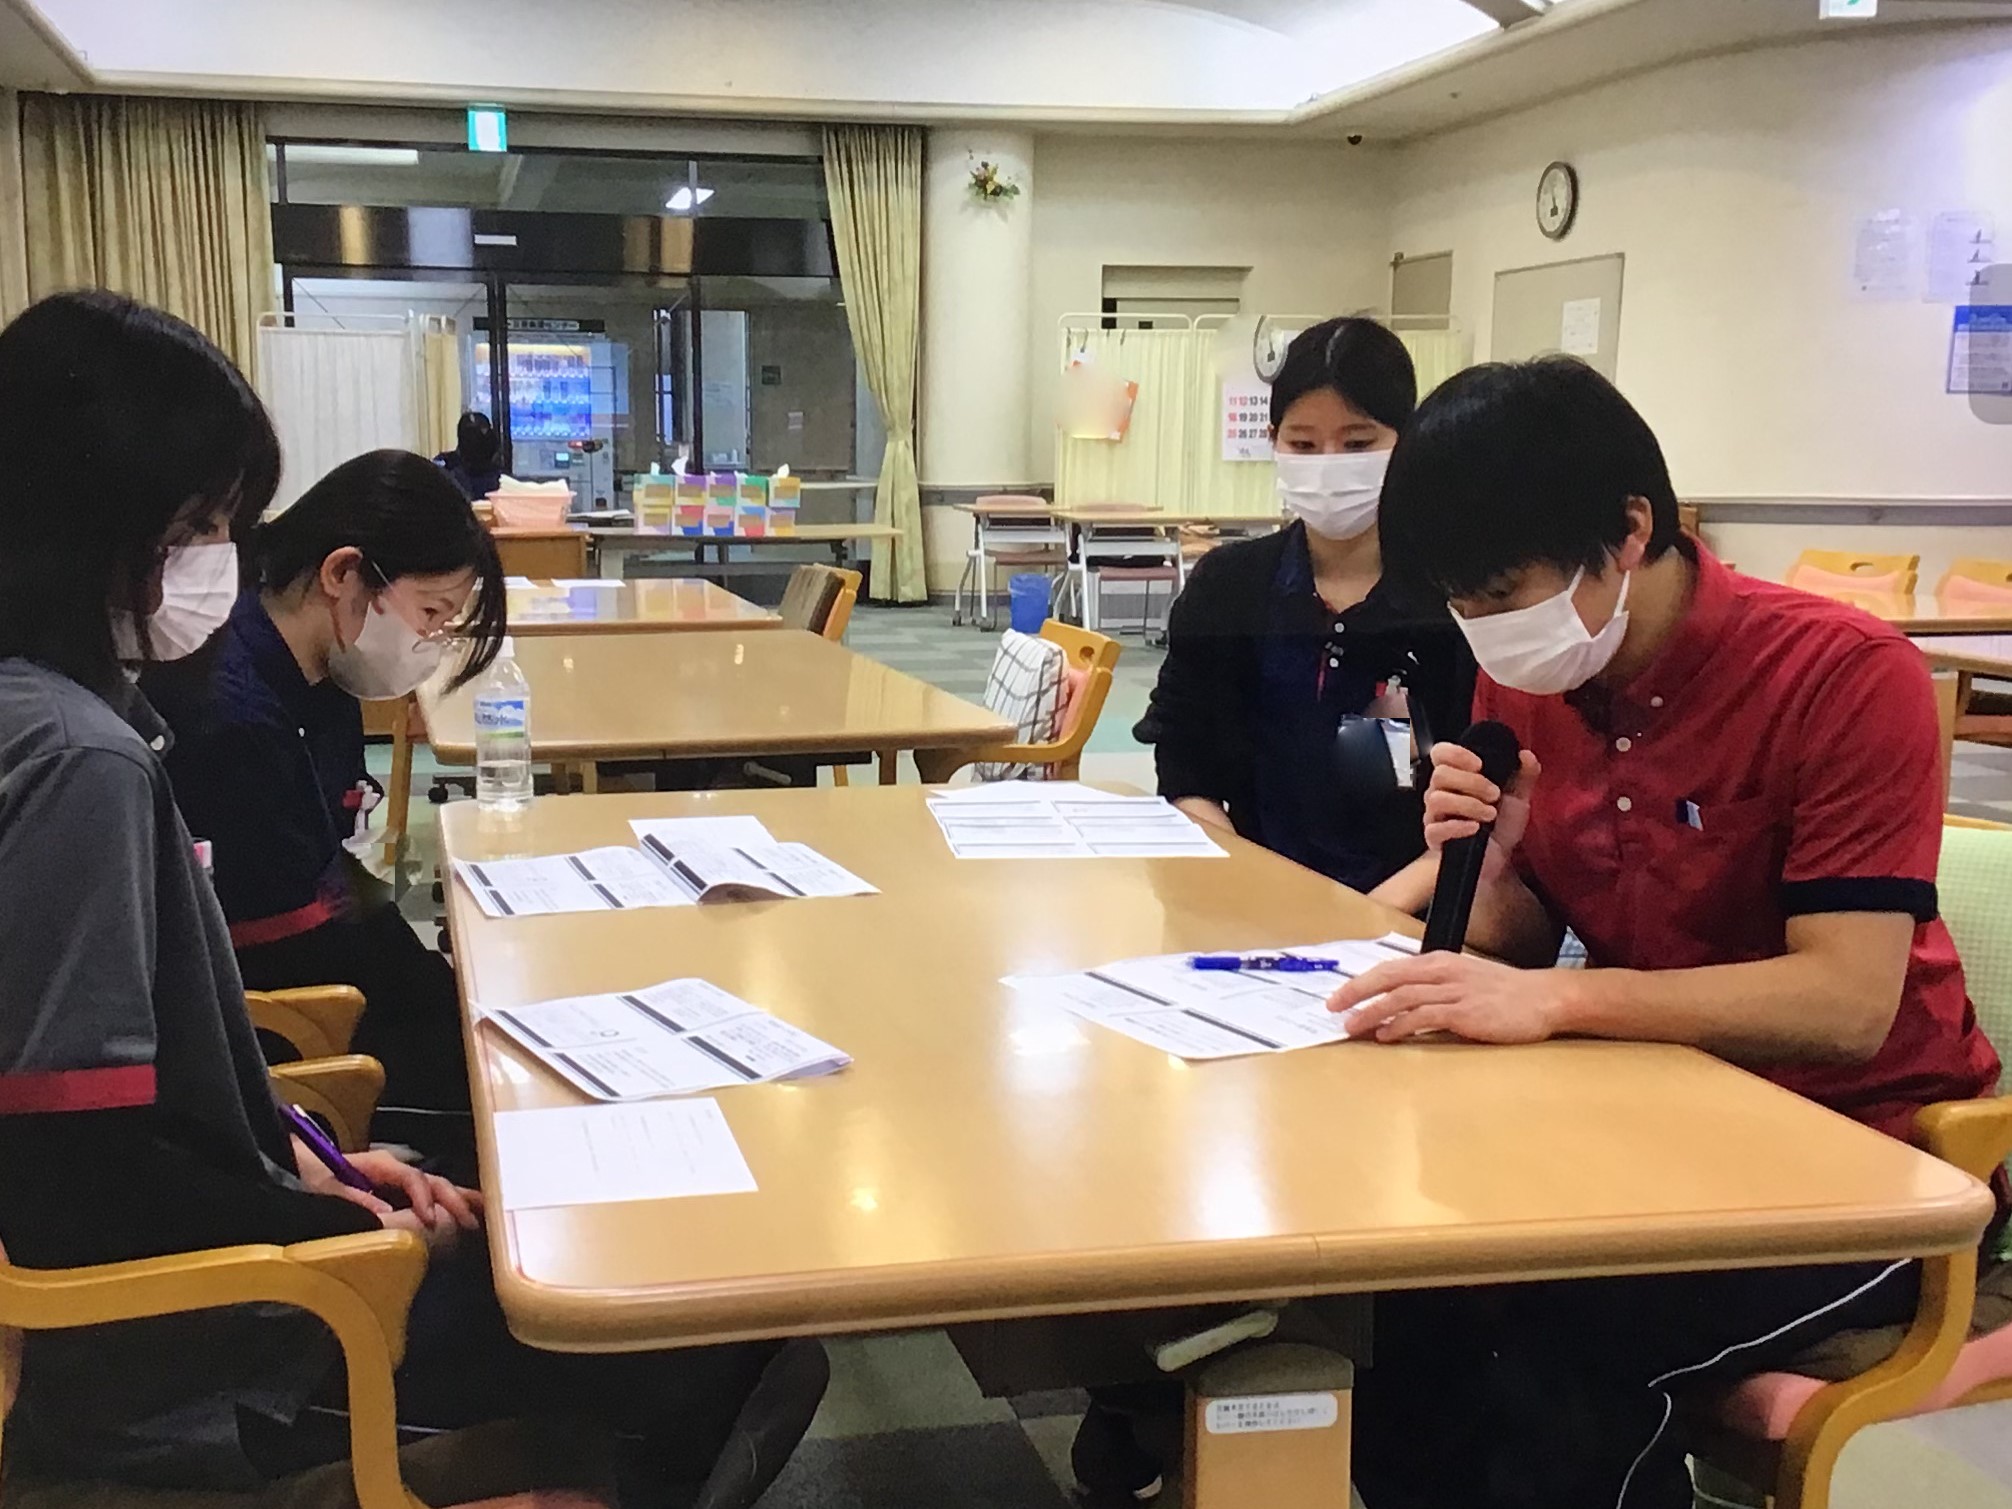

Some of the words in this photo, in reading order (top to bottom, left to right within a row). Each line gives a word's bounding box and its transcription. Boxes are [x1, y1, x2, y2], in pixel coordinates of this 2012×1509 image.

[1250, 396, 1258, 406] 13
[1260, 396, 1268, 406] 14
[1239, 412, 1248, 422] 19
[1249, 412, 1258, 422] 20
[1260, 412, 1268, 422] 21
[1238, 428, 1247, 438] 26
[1249, 428, 1258, 438] 27
[1259, 428, 1268, 438] 28
